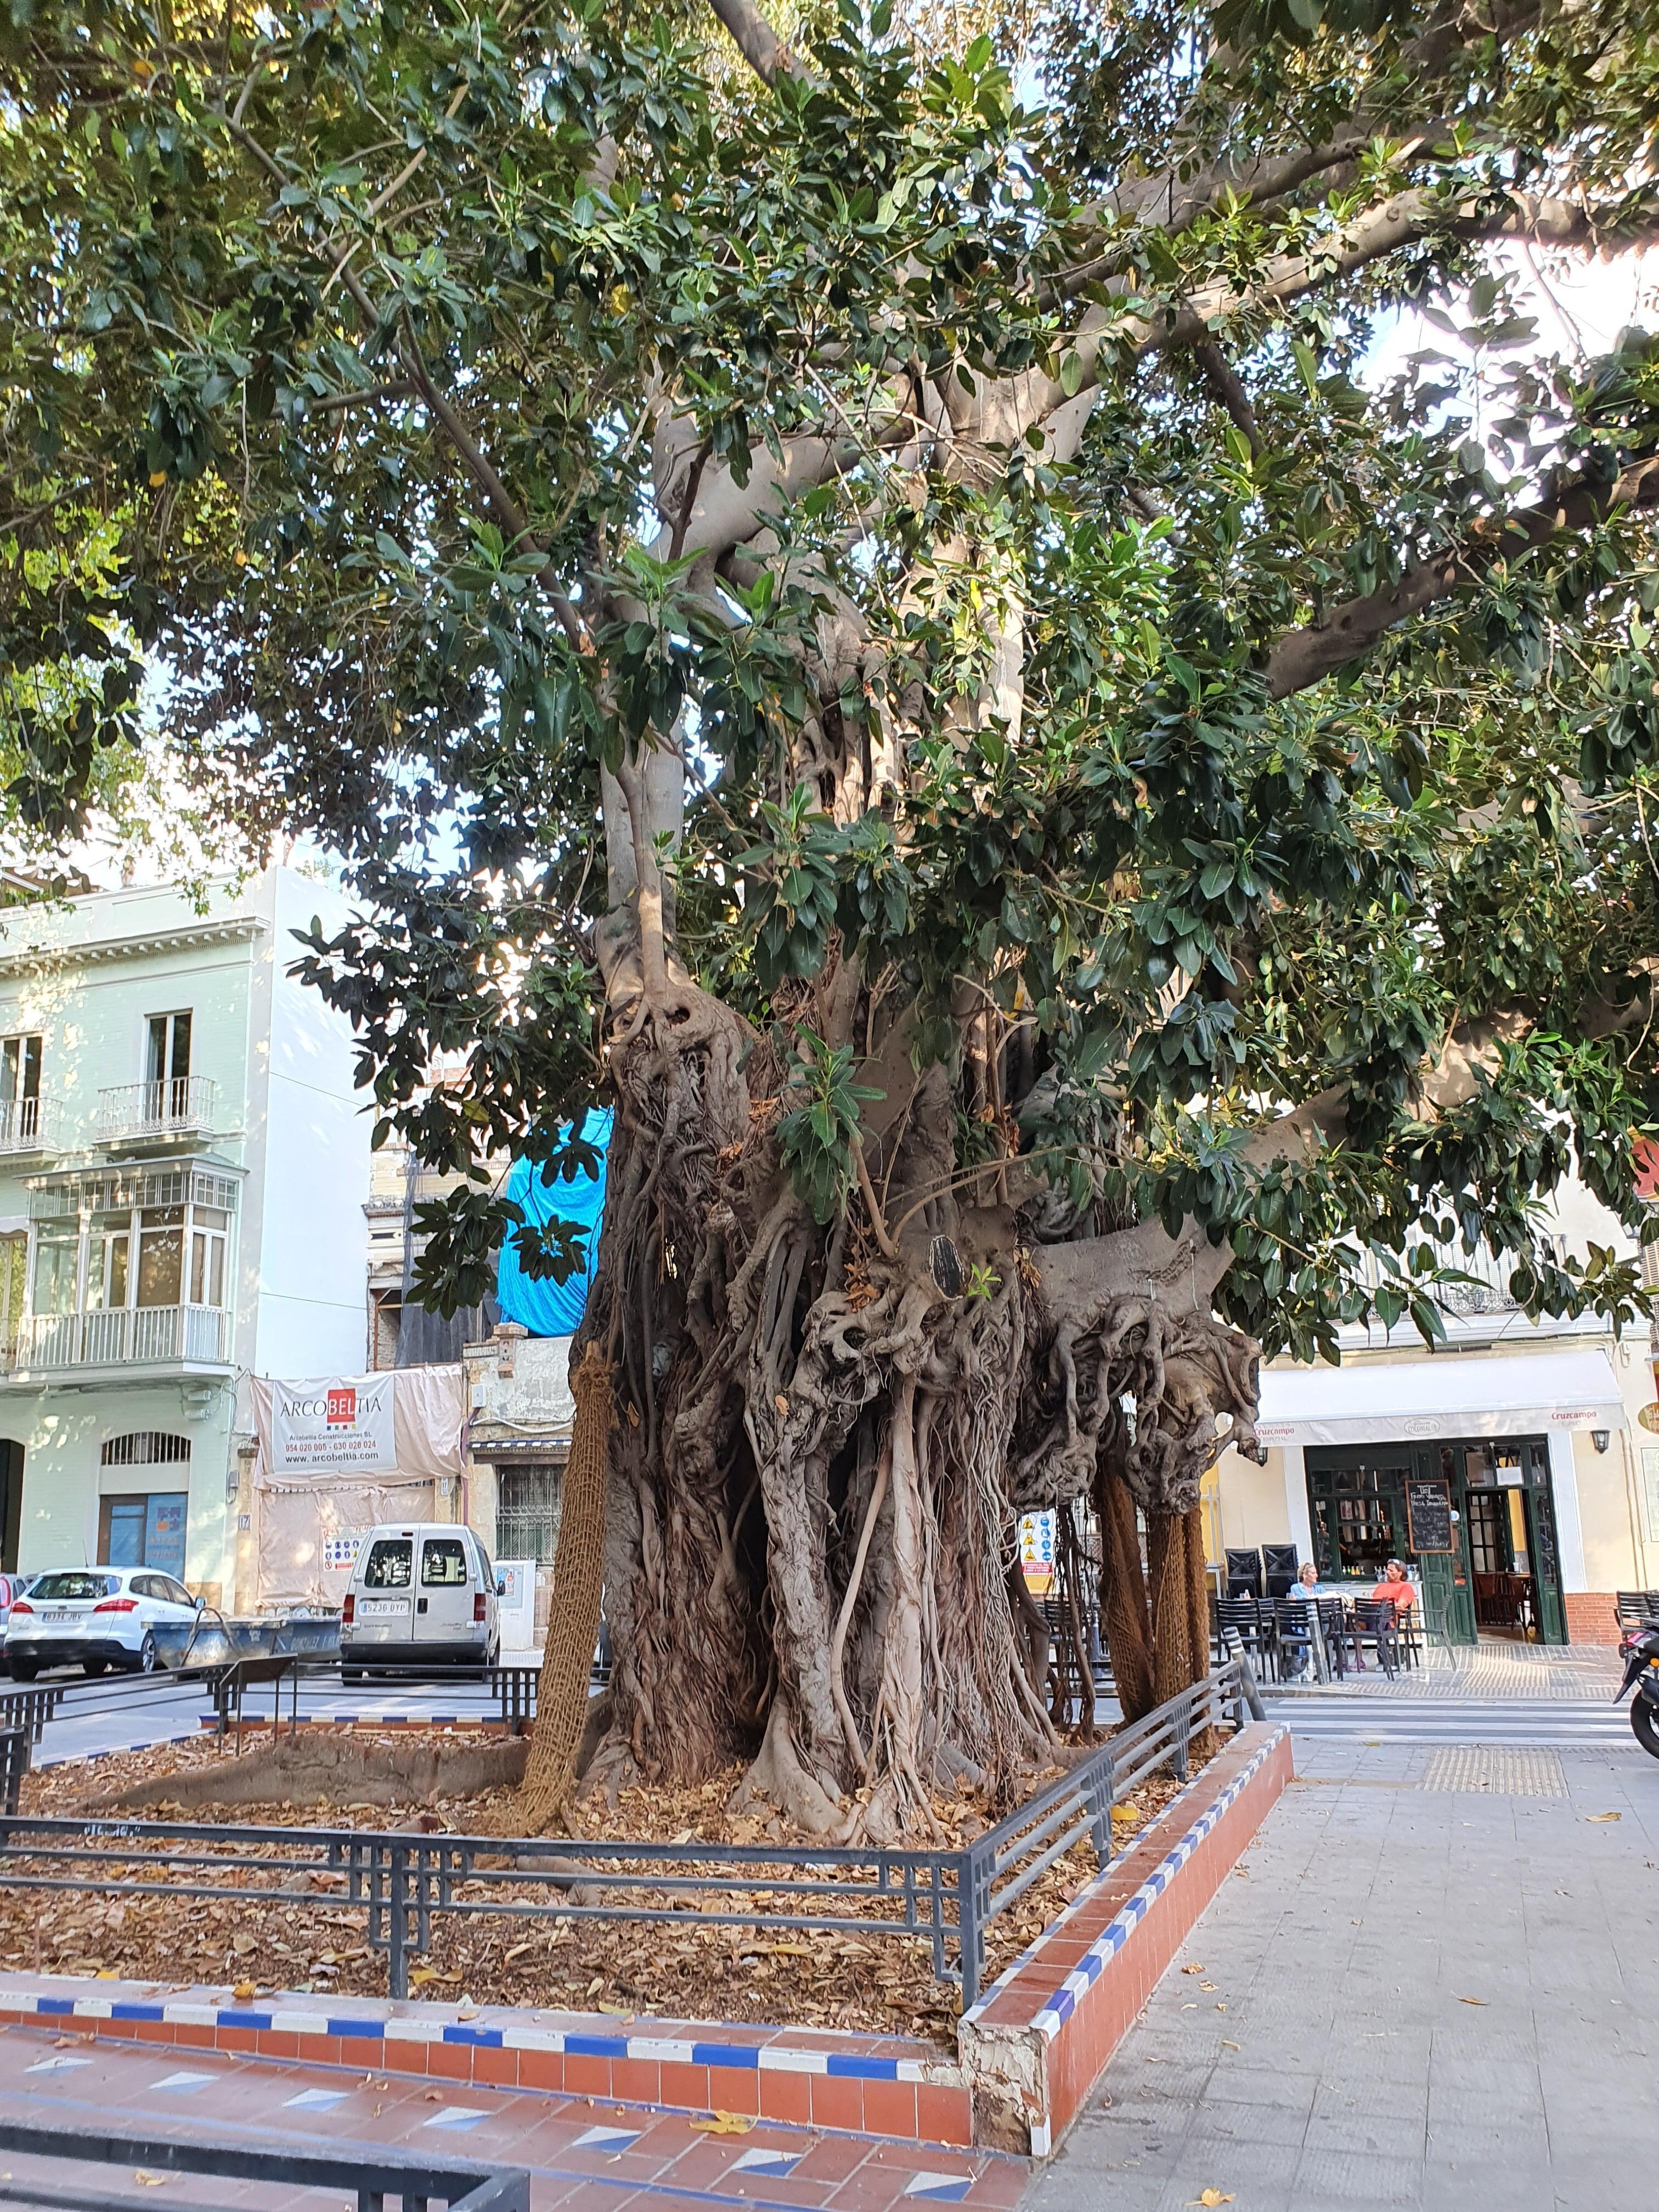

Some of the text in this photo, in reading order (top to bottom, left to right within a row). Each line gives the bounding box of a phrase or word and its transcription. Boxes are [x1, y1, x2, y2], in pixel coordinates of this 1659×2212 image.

[280, 1396, 381, 1418] ARCOBELTIA
[1551, 1411, 1597, 1420] Cruzcampo
[318, 1432, 363, 1440] Construcciones
[285, 1443, 297, 1452] 954
[300, 1443, 312, 1452] 020
[363, 1440, 376, 1449] 024
[312, 1452, 379, 1463] arcobeltia.com
